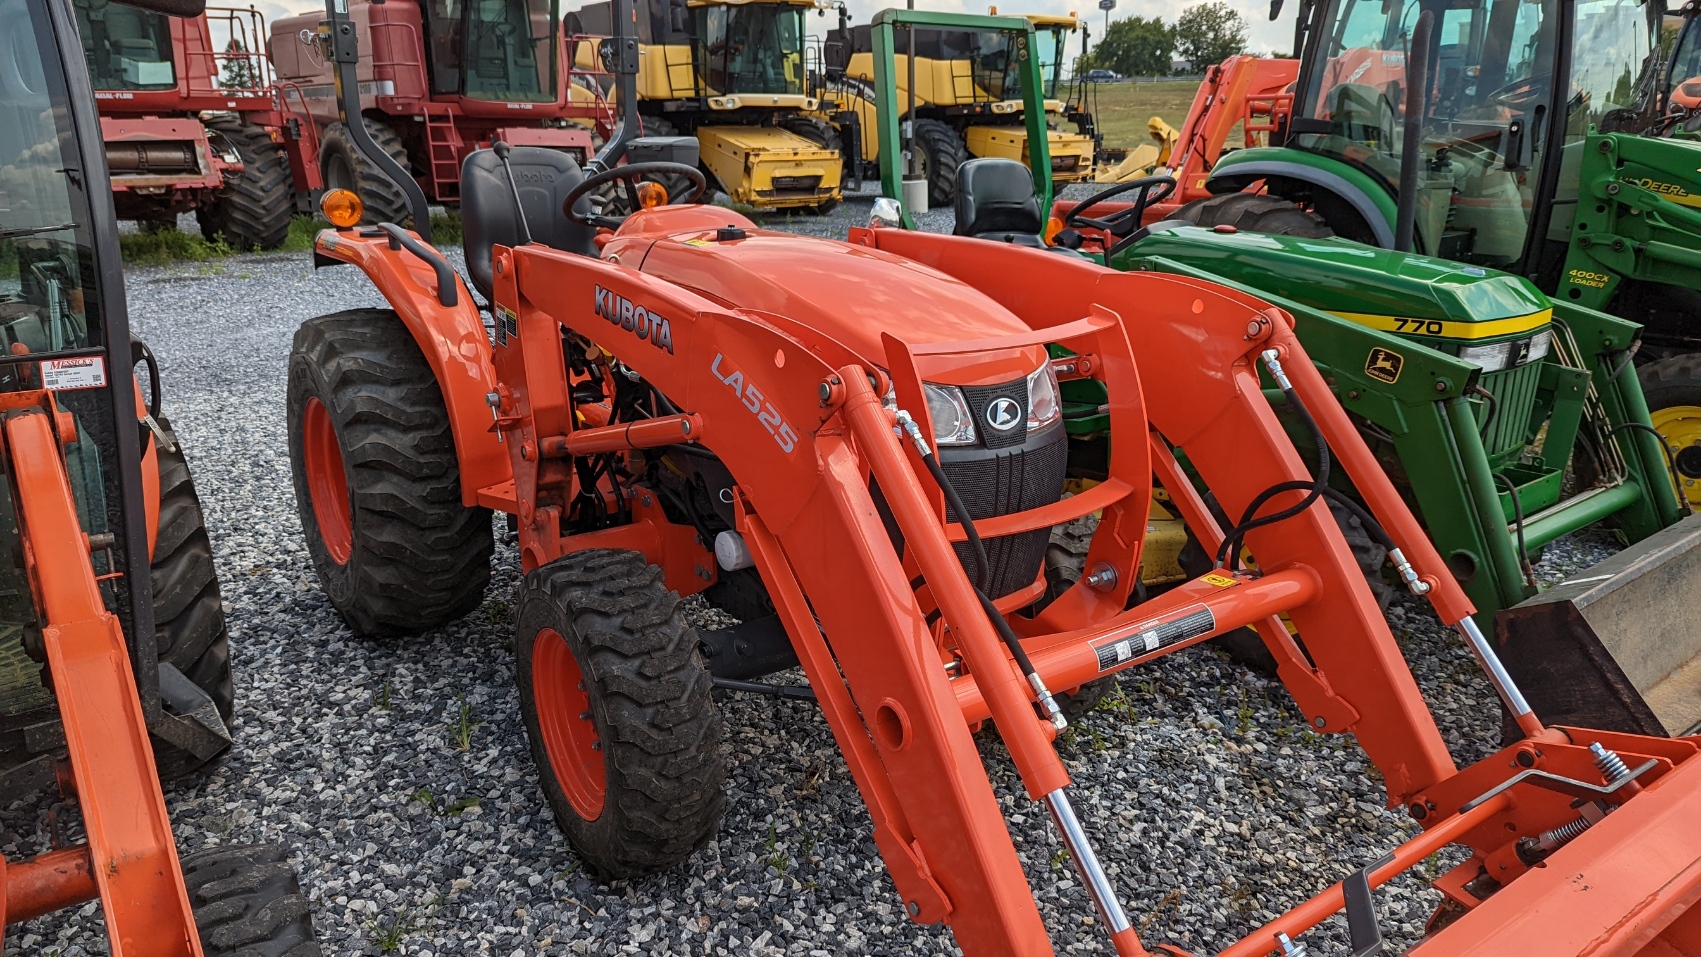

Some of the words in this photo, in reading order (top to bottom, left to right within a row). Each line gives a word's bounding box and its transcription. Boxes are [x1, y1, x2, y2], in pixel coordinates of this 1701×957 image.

[1569, 269, 1610, 282] 400CX
[1569, 277, 1605, 288] LOADER
[594, 283, 674, 356] KUBOTA
[1393, 317, 1443, 335] 770
[711, 352, 799, 454] LA525
